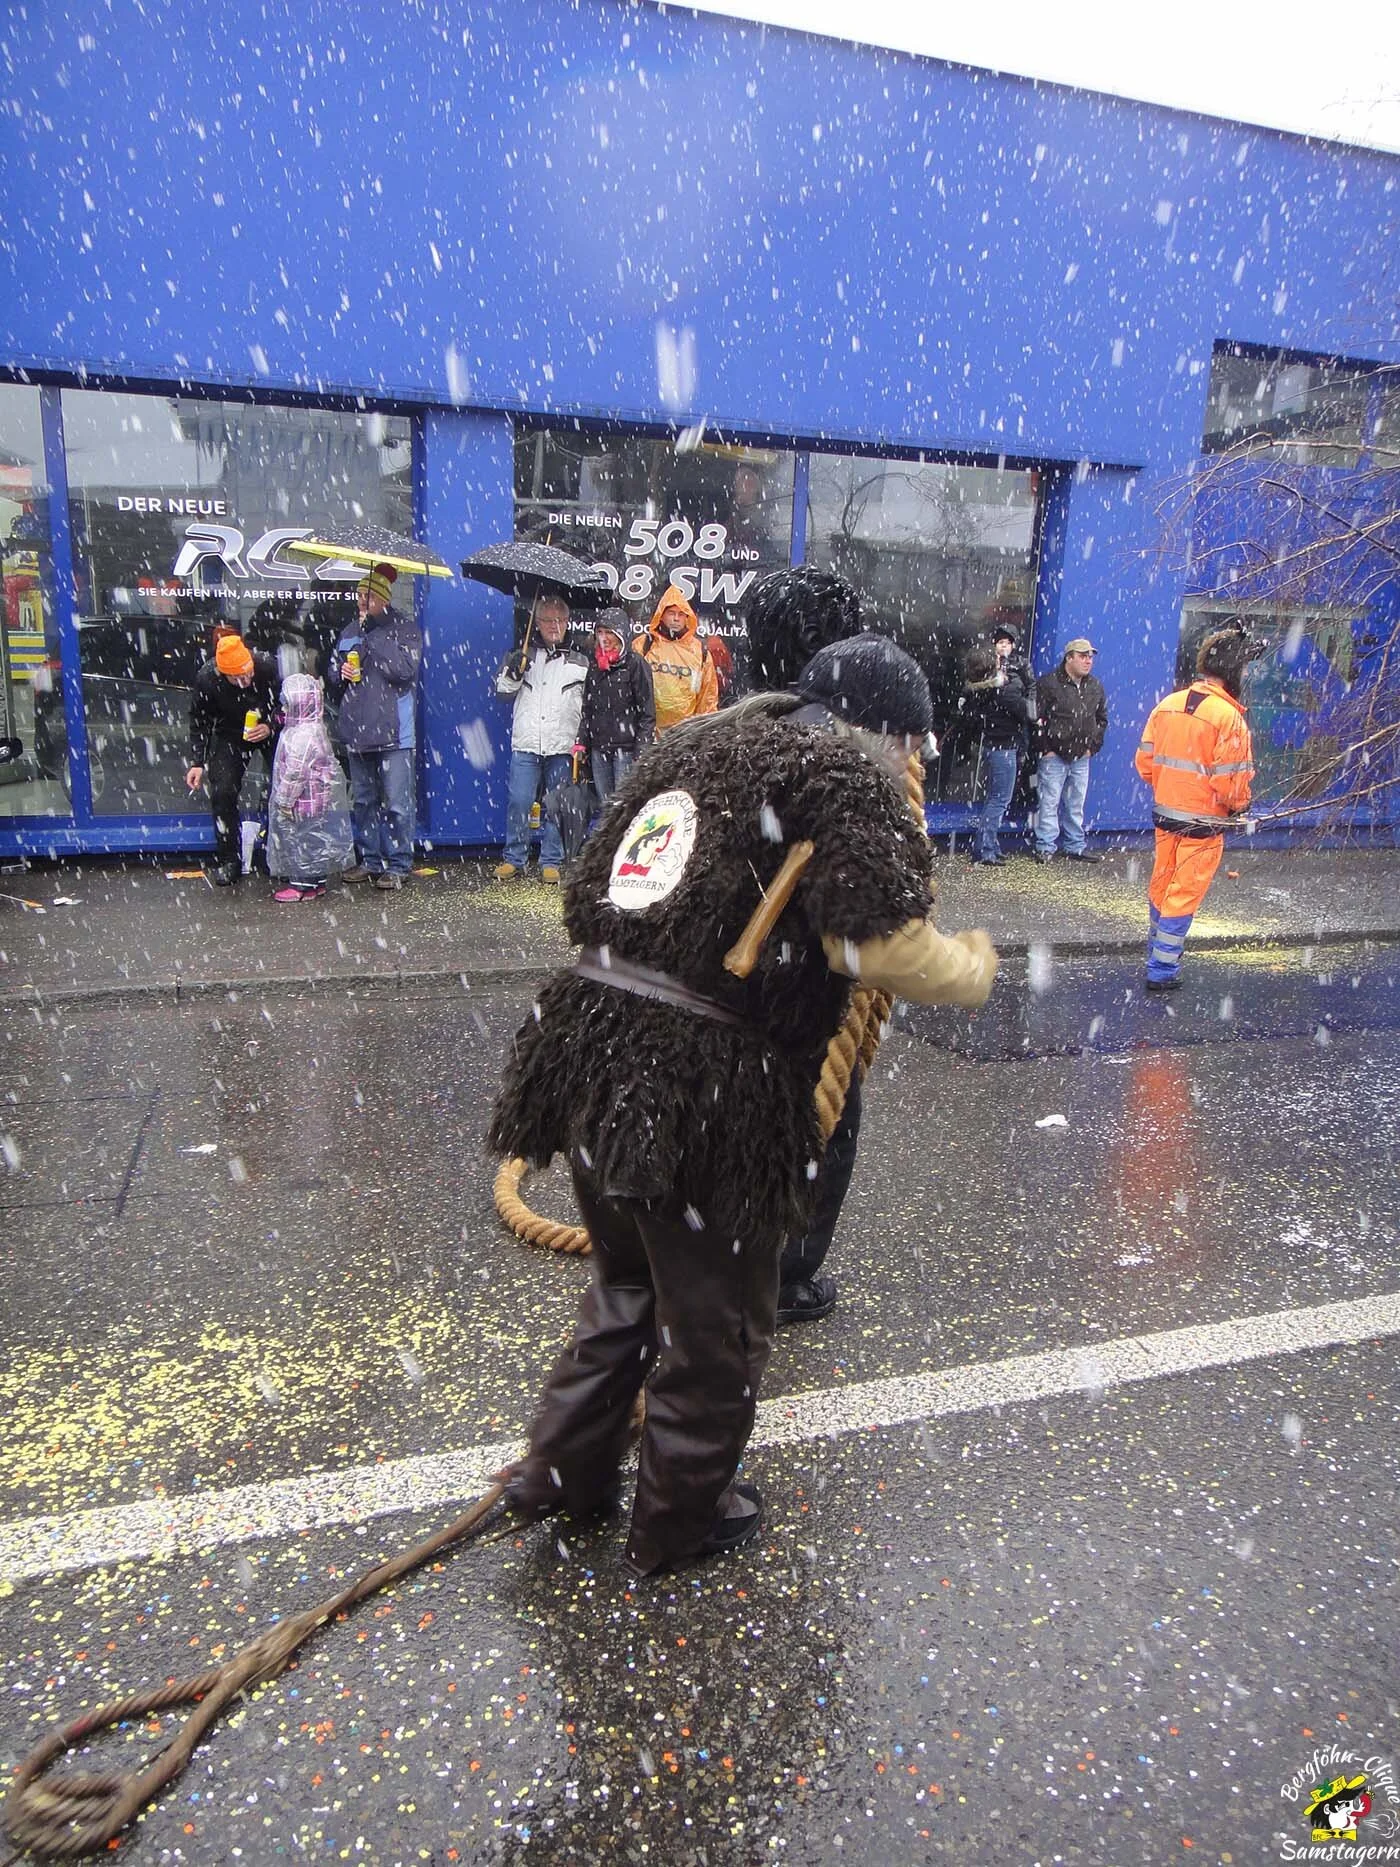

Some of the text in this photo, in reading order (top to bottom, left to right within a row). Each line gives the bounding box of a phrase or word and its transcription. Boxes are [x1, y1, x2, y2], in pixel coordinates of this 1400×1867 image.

[117, 496, 227, 515] DER NEUE
[548, 513, 760, 562] DIE NEUEN 508 UND
[589, 562, 757, 604] 08 SW
[137, 587, 157, 597] SIE
[160, 588, 210, 599] KAUFEN
[213, 589, 241, 600] IHN,
[243, 590, 275, 600] ABER
[277, 590, 293, 600] ER
[295, 590, 342, 601] BESITZT
[696, 624, 749, 638] QUALITÄ
